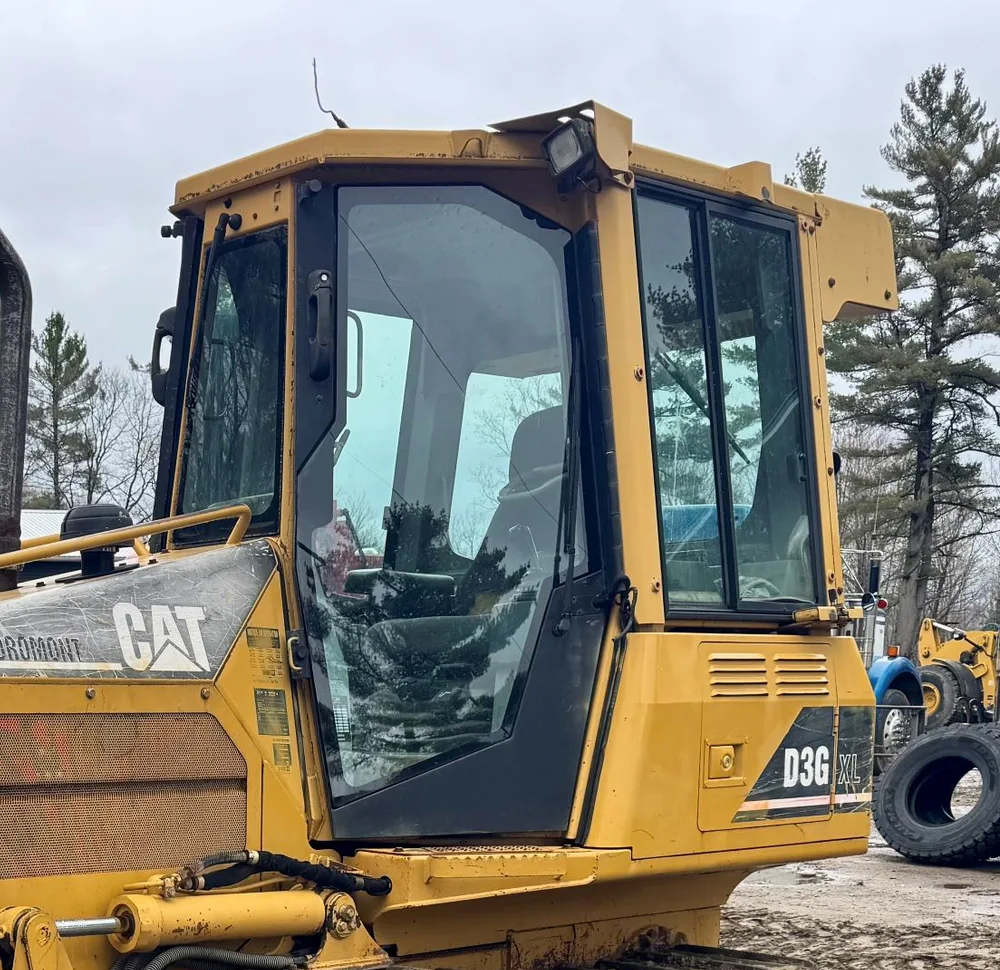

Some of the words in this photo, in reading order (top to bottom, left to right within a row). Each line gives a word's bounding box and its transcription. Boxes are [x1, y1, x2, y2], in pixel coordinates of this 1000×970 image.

[113, 602, 211, 672] CAT
[783, 745, 830, 788] D3G
[837, 753, 861, 785] XL
